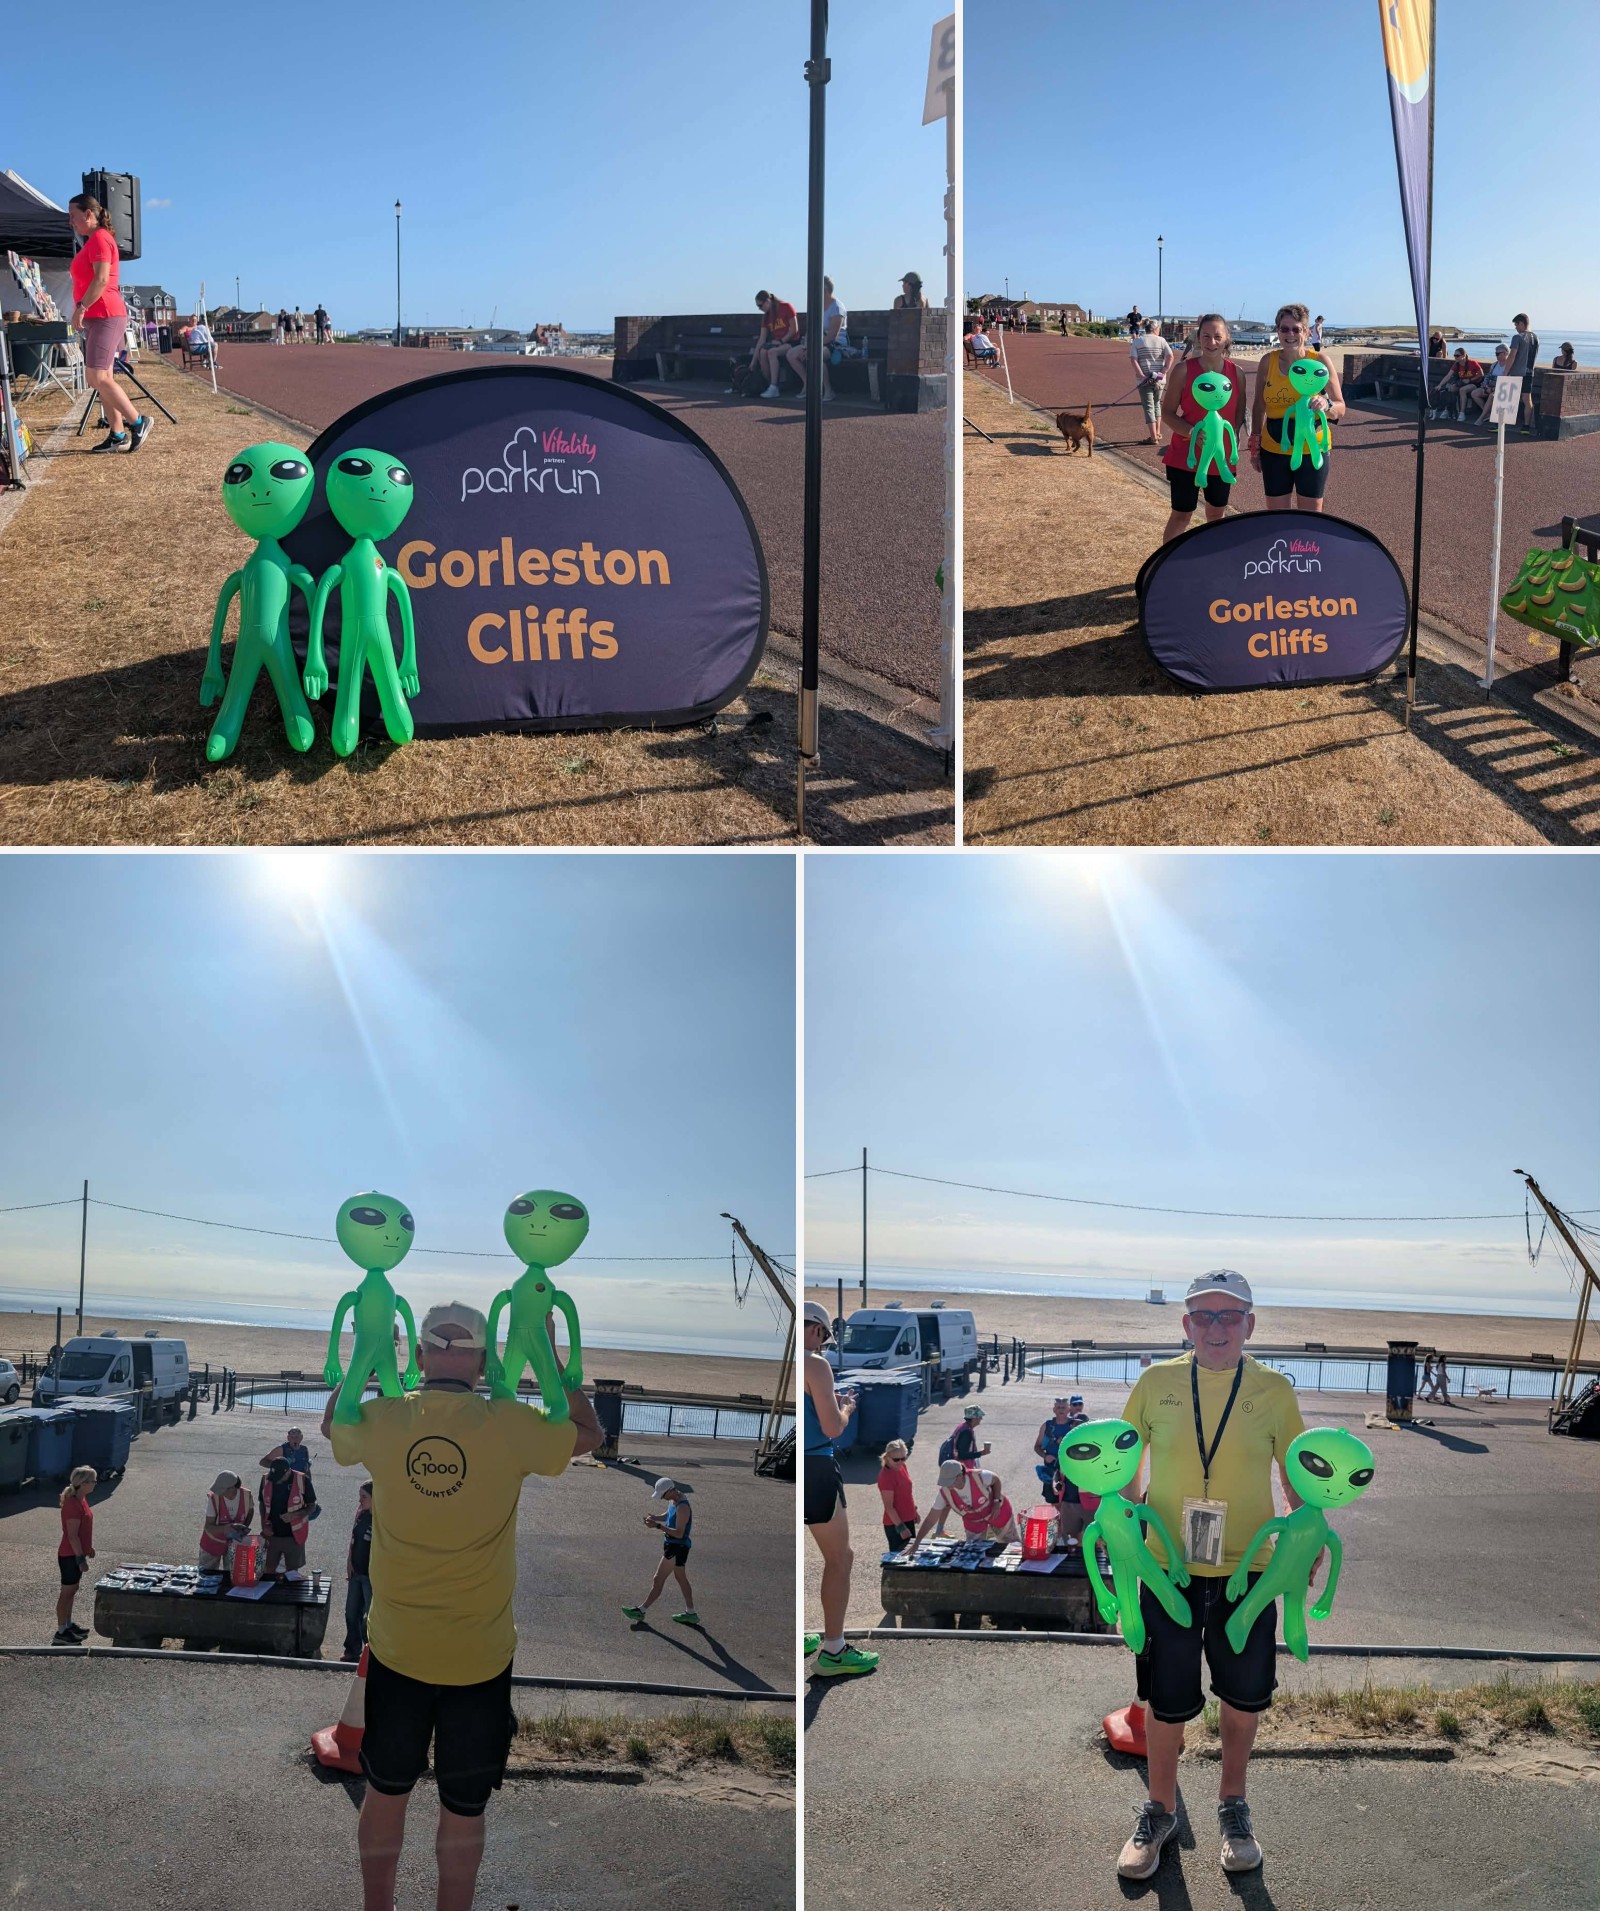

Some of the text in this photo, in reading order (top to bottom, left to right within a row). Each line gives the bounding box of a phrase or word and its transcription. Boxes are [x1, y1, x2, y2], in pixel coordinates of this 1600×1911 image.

[542, 427, 597, 463] Vitality
[460, 449, 600, 502] parkrun
[396, 536, 671, 589] Gorleston
[1289, 539, 1320, 556] Vitality
[1244, 550, 1322, 580] parkrun
[1208, 593, 1358, 623] Gorleston
[467, 605, 619, 664] Cliffs
[1247, 628, 1328, 658] Cliffs
[1160, 1396, 1183, 1407] parkrun
[421, 1463, 459, 1477] 1000
[410, 1477, 464, 1498] VOLUNTEER
